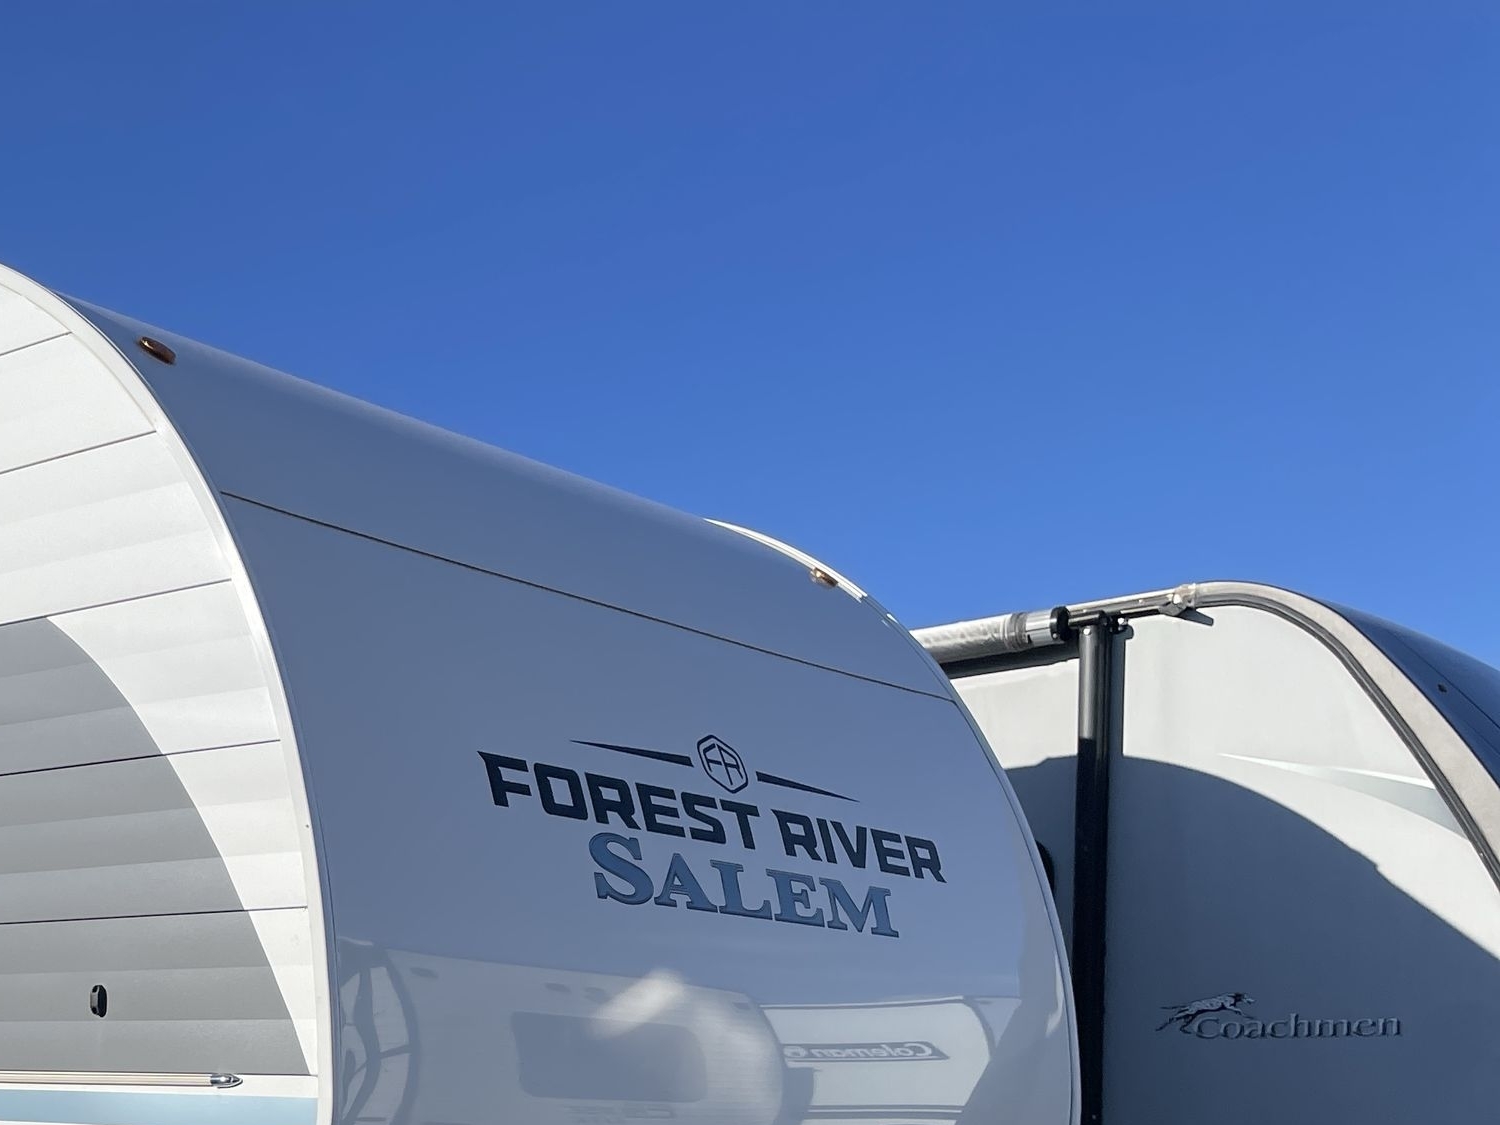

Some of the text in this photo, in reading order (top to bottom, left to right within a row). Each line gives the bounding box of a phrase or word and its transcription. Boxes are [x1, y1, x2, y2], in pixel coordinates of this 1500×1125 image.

[476, 750, 947, 884] FOREST RIVER
[588, 831, 900, 938] SALEM
[1194, 1012, 1402, 1040] Coachmen
